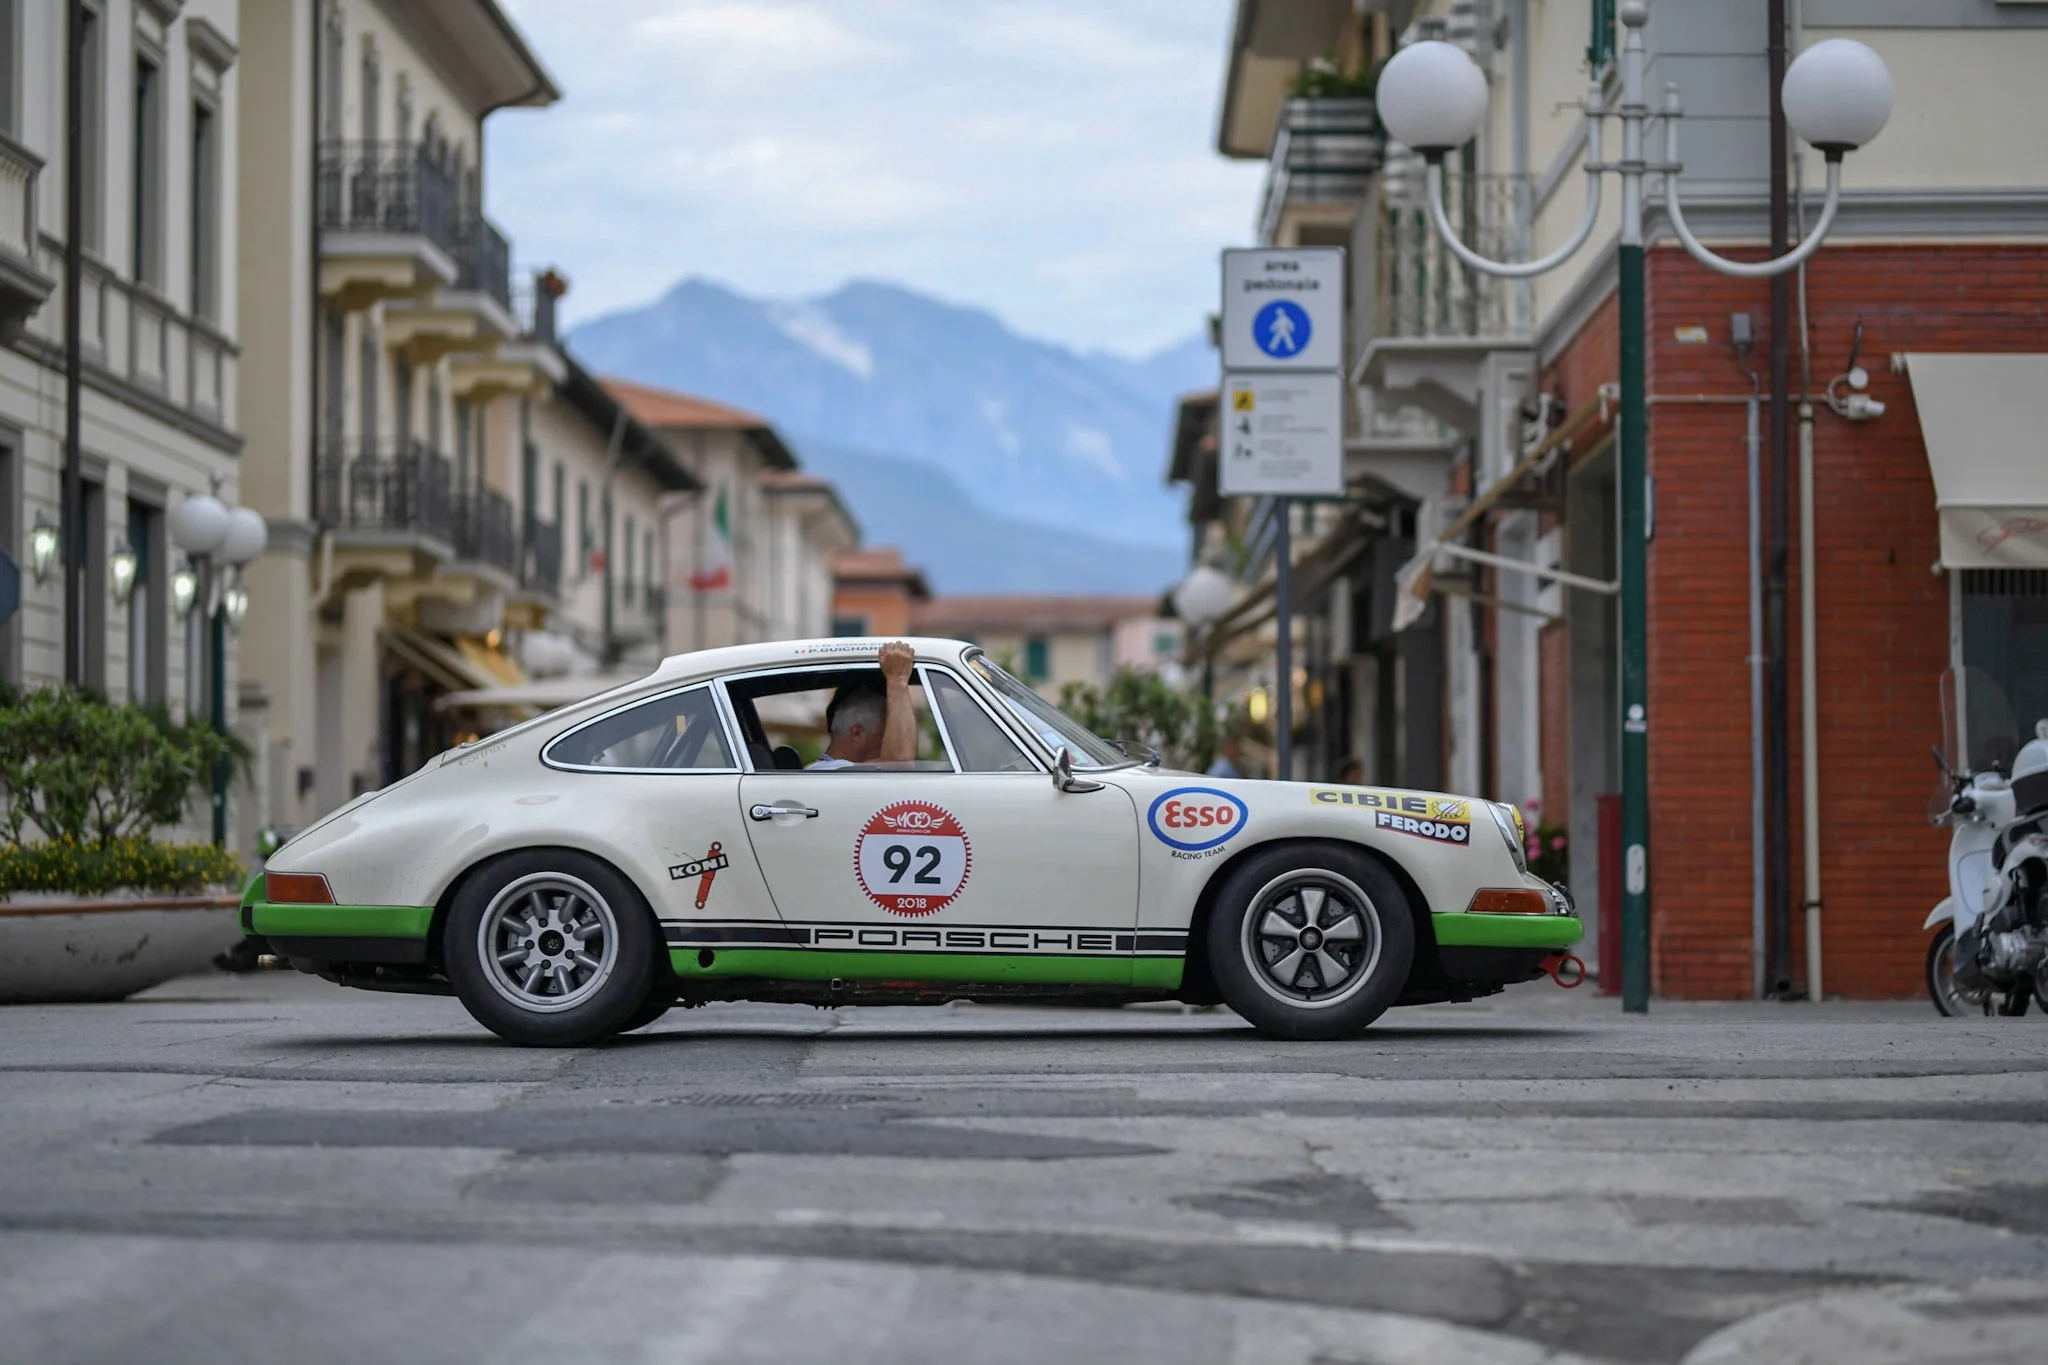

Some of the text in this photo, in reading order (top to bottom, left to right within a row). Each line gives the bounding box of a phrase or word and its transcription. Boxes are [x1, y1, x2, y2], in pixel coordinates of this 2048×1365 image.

[1264, 260, 1300, 272] area
[1243, 277, 1321, 292] pedonale
[808, 646, 877, 655] P.GUICHAR
[1378, 813, 1468, 841] FERODO
[1171, 845, 1227, 860] RACING TEAM
[671, 855, 727, 878] KONI
[883, 844, 941, 884] 92
[896, 897, 927, 909] 2018
[814, 928, 1112, 950] PORSCHE
